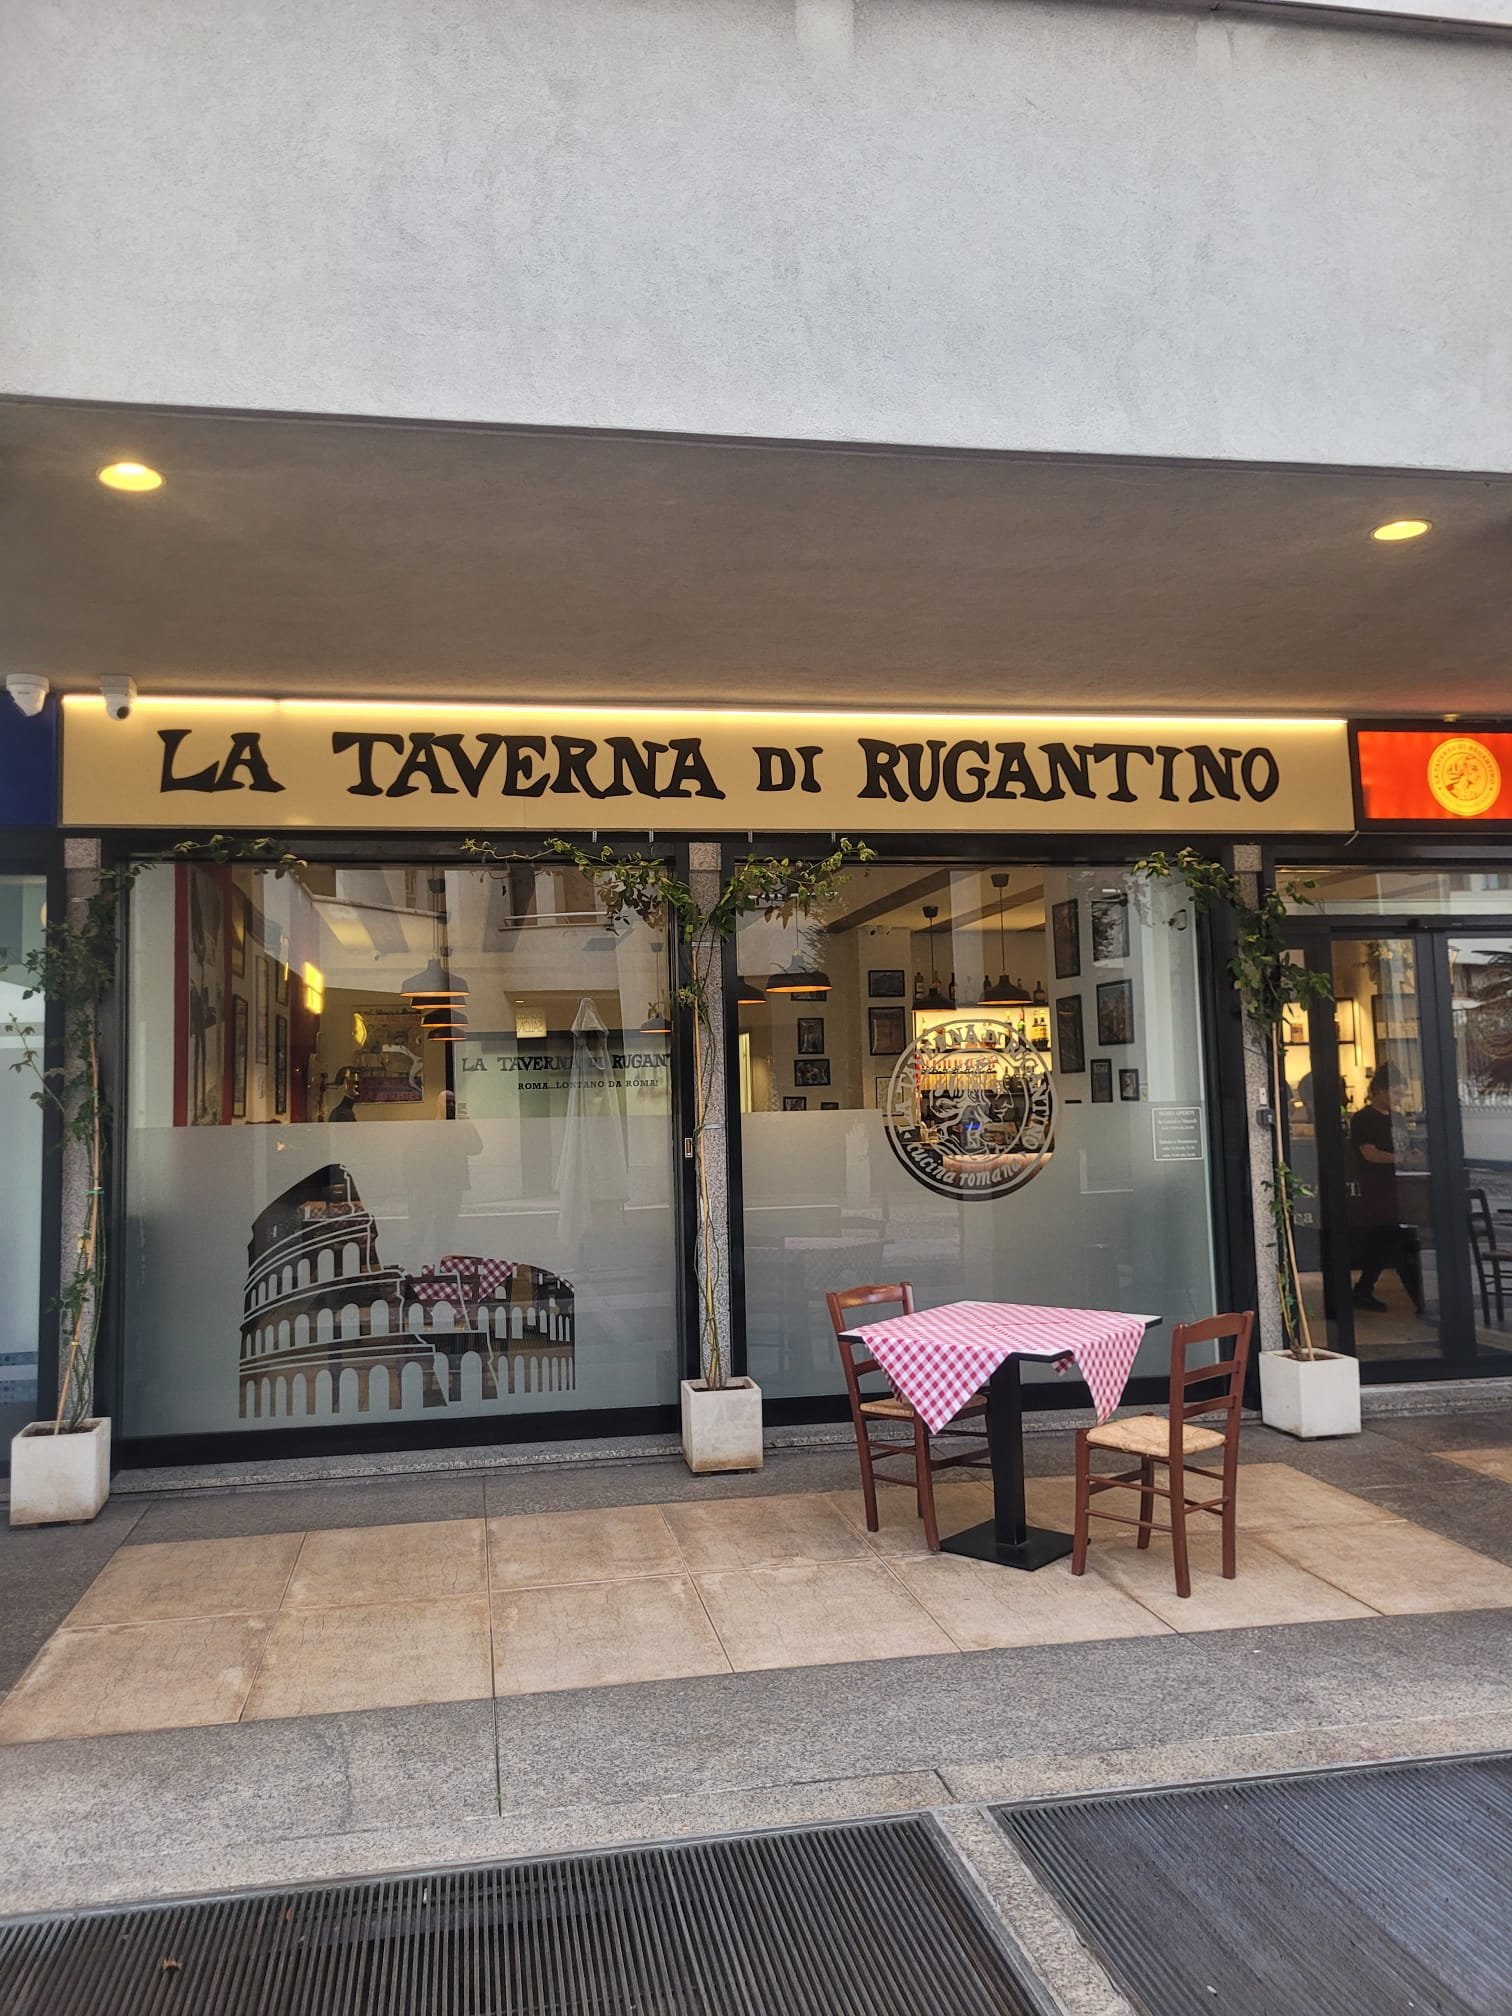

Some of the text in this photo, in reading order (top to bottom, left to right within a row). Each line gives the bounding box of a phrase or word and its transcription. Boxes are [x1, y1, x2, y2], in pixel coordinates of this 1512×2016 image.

[158, 729, 1280, 804] LA TAVERNA DI RUGANTINO
[461, 1057, 488, 1072] LA
[608, 1079, 623, 1088] DA
[625, 1078, 659, 1088] ROMA!
[906, 1142, 1024, 1187] cucina romana
